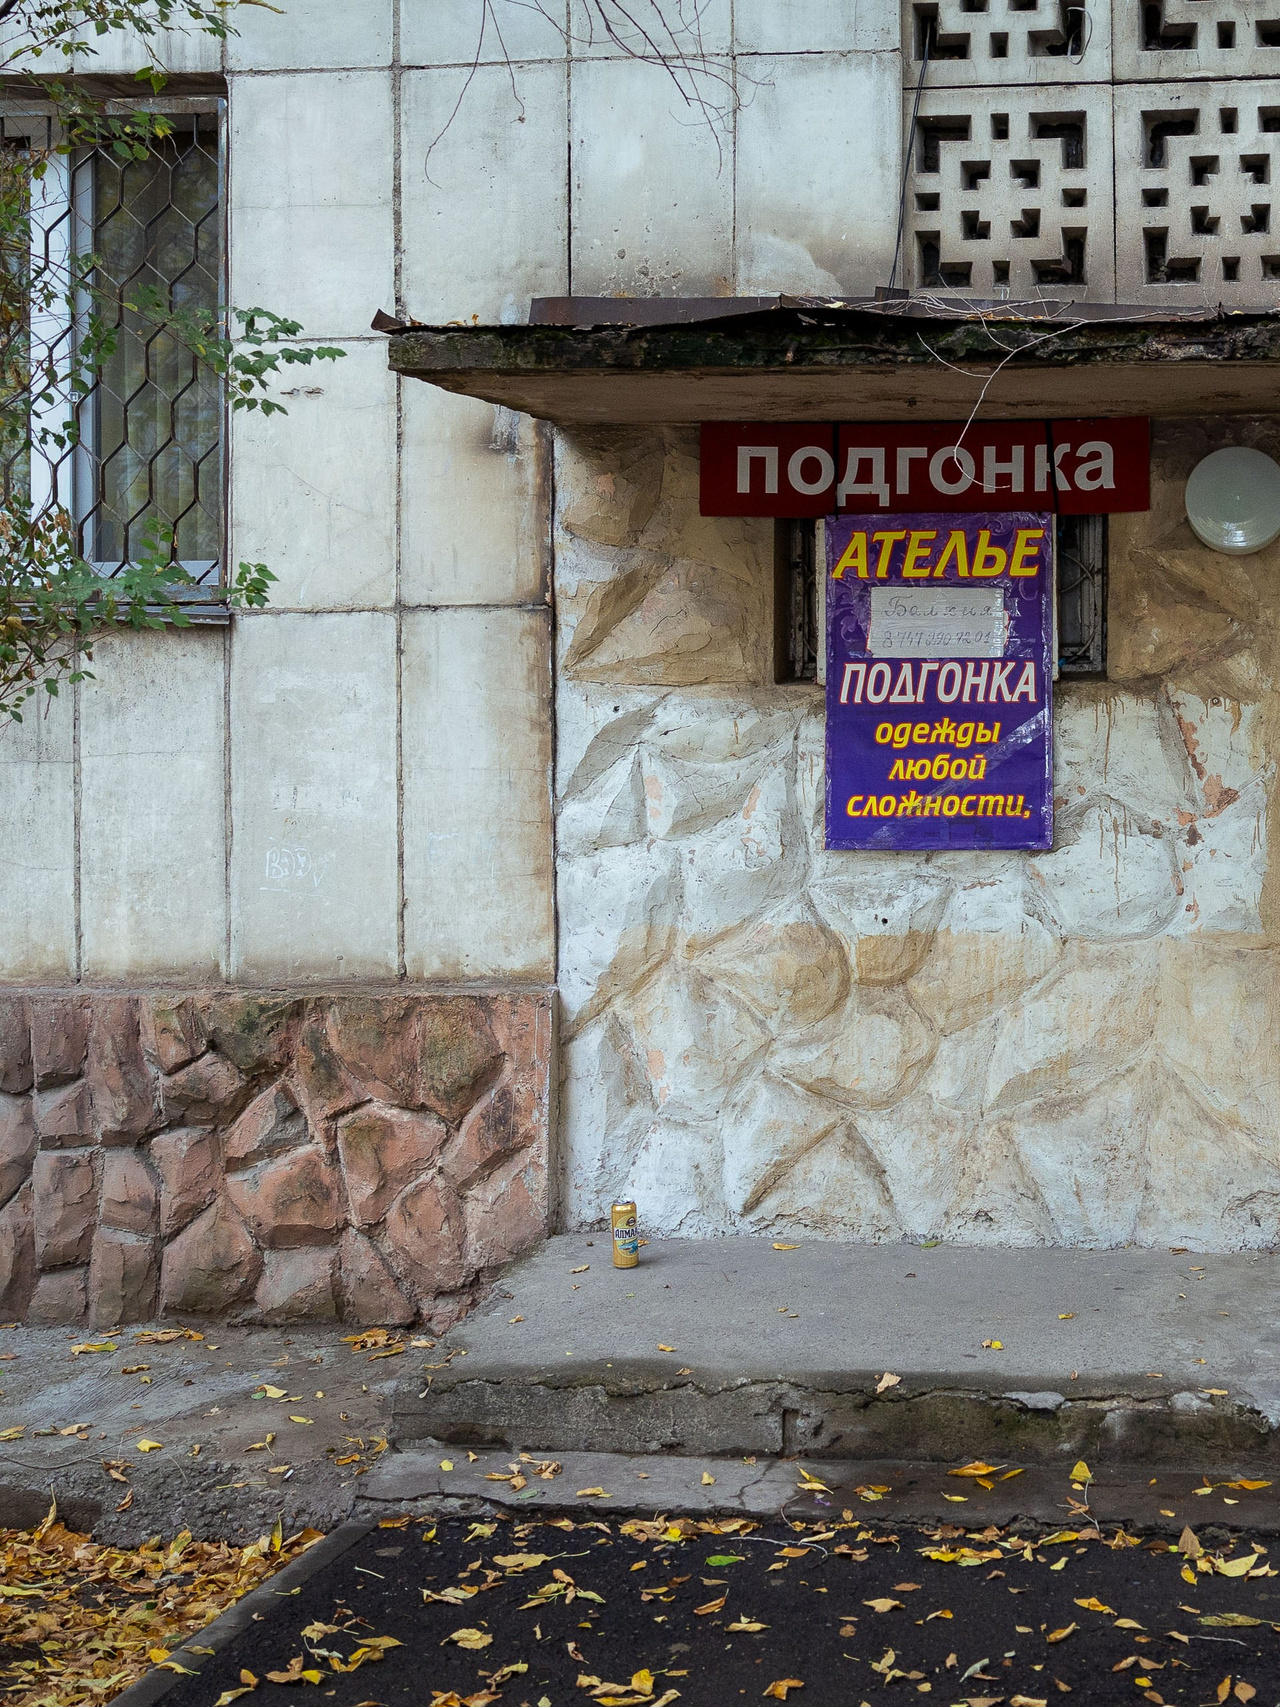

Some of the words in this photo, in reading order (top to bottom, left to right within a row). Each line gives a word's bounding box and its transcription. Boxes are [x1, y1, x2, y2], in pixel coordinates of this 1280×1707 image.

[736, 440, 1116, 507] подгонка
[831, 529, 1045, 580] АТЕЛЬЕ
[840, 662, 1037, 704] ПОДГОНКА
[875, 717, 1001, 748] одежды
[888, 754, 987, 781] любой
[846, 790, 1031, 819] сложности,
